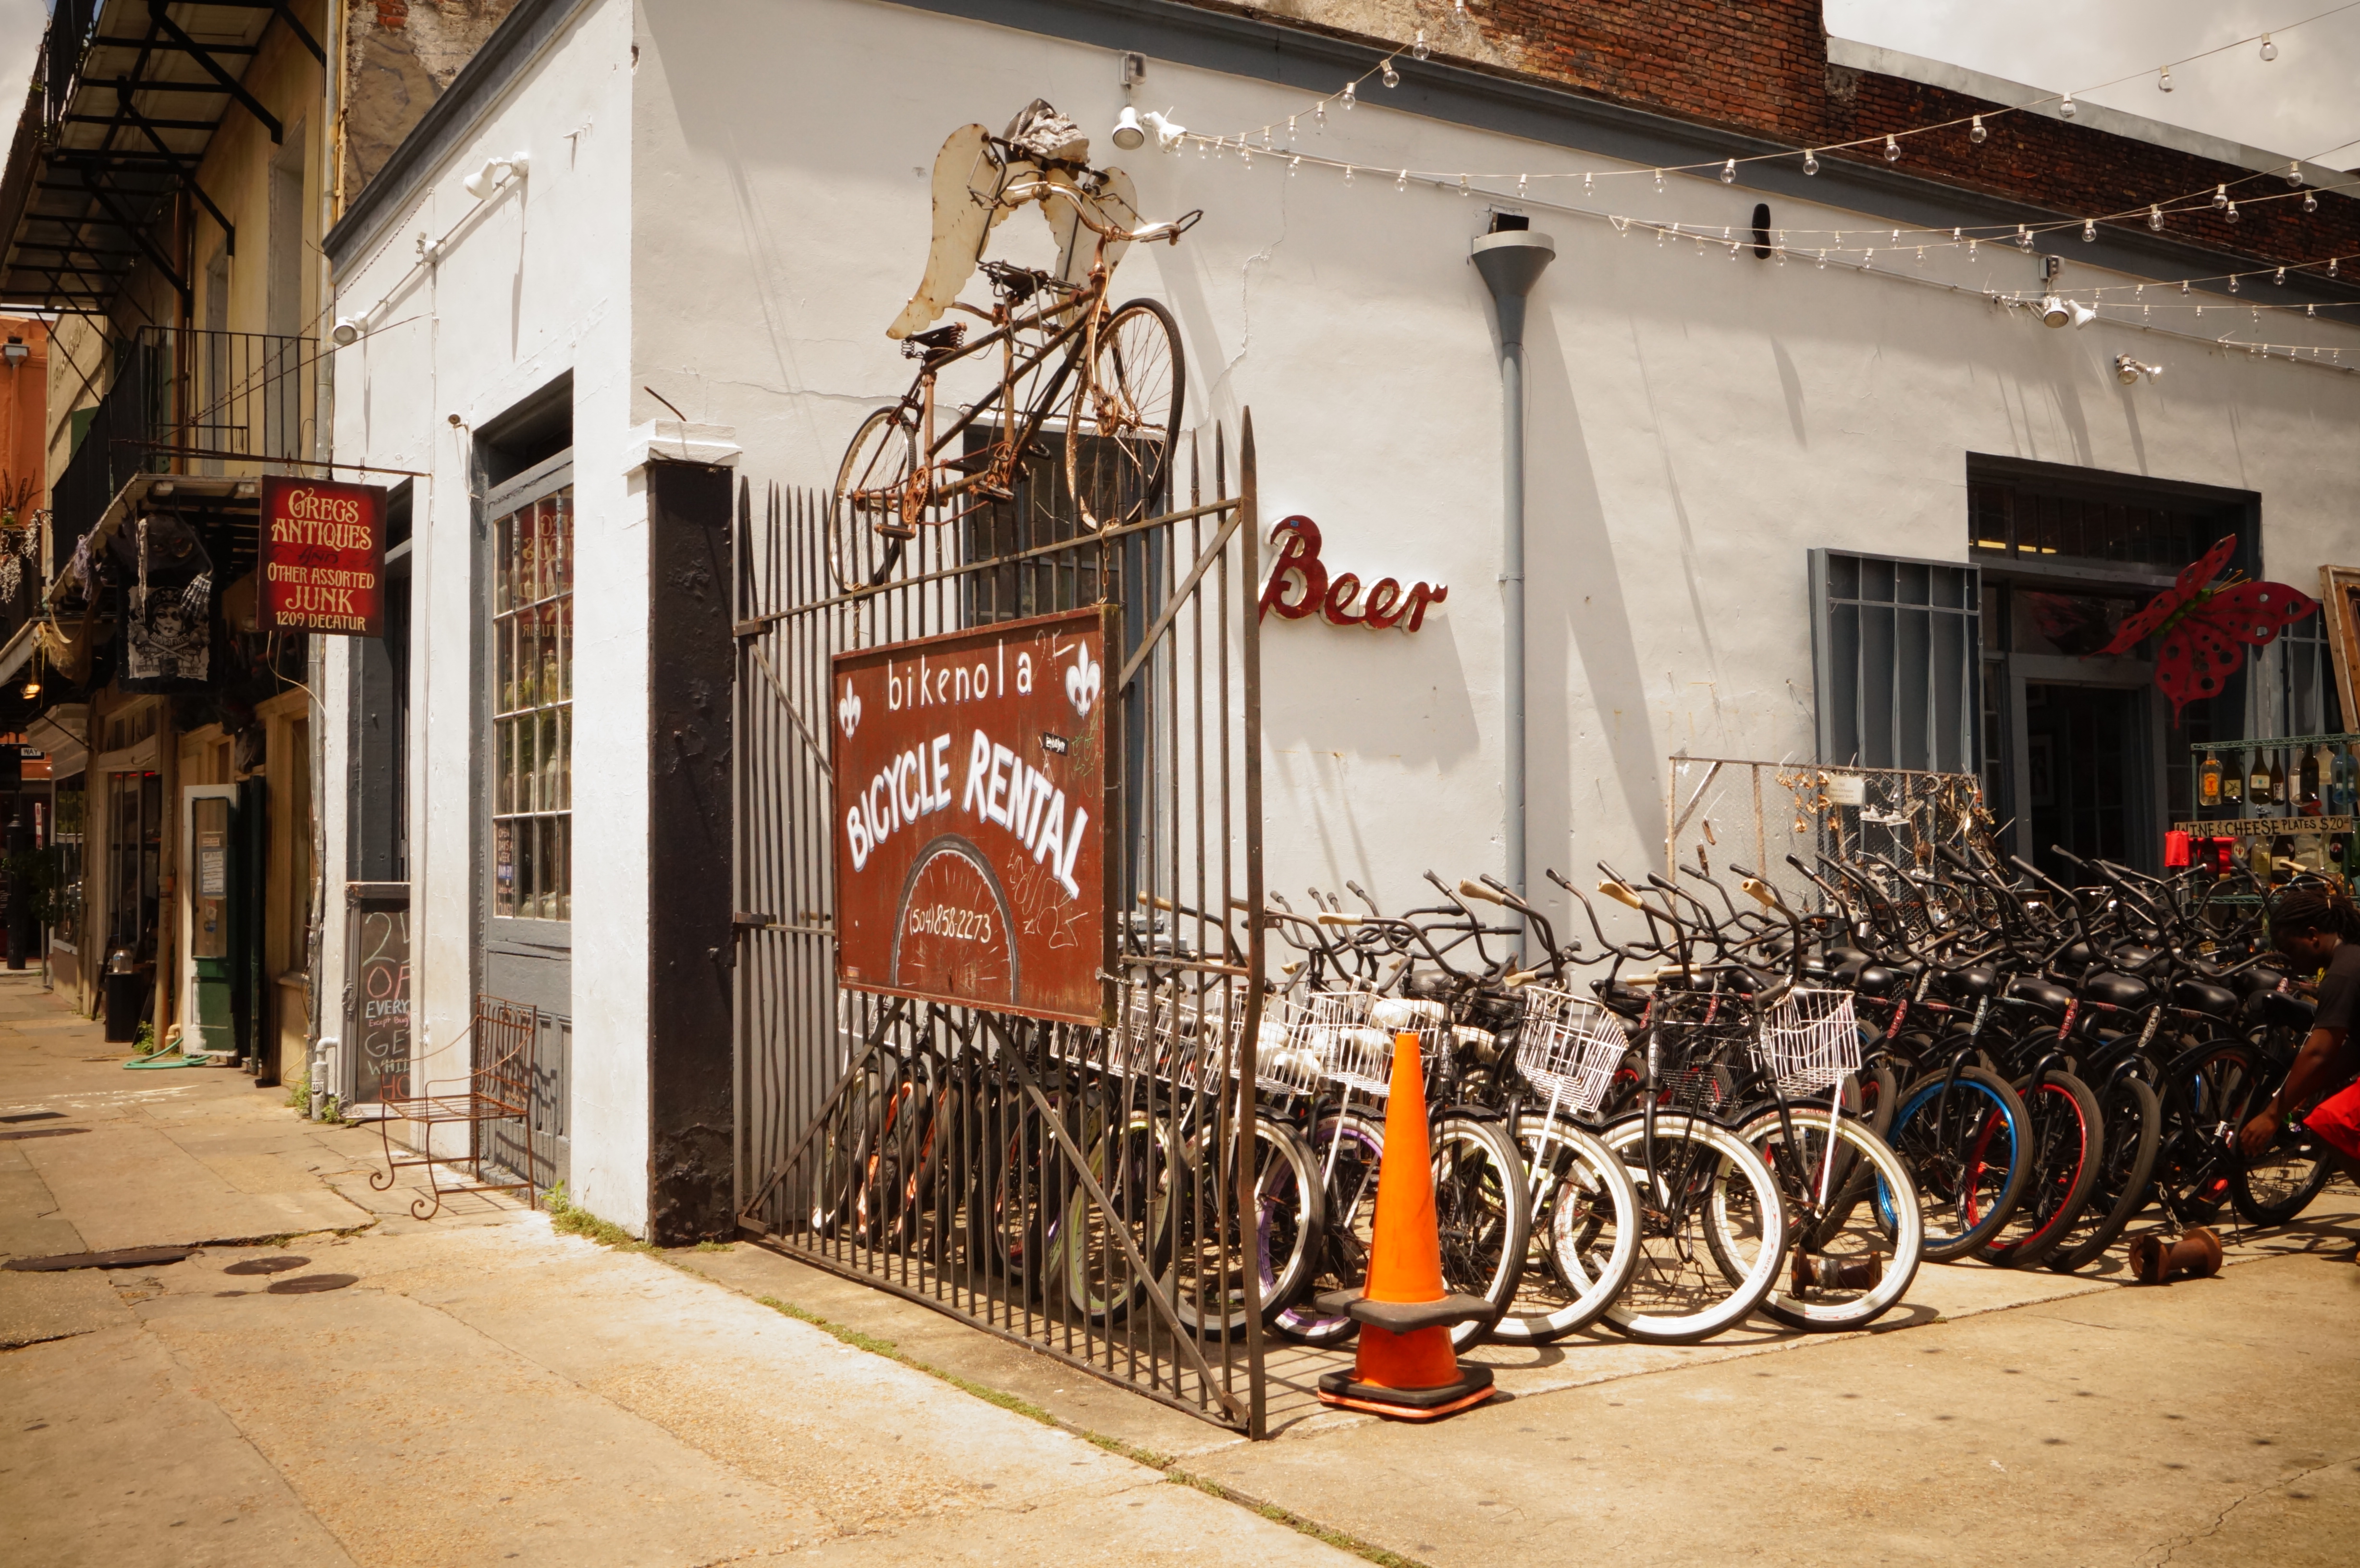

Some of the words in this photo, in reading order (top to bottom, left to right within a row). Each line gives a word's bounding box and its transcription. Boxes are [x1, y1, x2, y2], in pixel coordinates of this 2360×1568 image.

[271, 518, 372, 551] ANTIQUES
[268, 562, 307, 584] OTHER
[310, 568, 375, 589] ASSORTED
[1259, 514, 1448, 633] Beer
[285, 585, 354, 613] JUNK
[275, 611, 304, 626] 1209
[309, 613, 366, 631] DECATUR
[846, 733, 952, 872] BICYCLE
[962, 729, 1089, 900] RENTAL
[2225, 821, 2280, 836] CHEESE
[2282, 819, 2317, 831] PLATES
[498, 852, 510, 863] WEEK
[909, 903, 992, 943] (504)858-2273
[369, 1016, 391, 1028] Except
